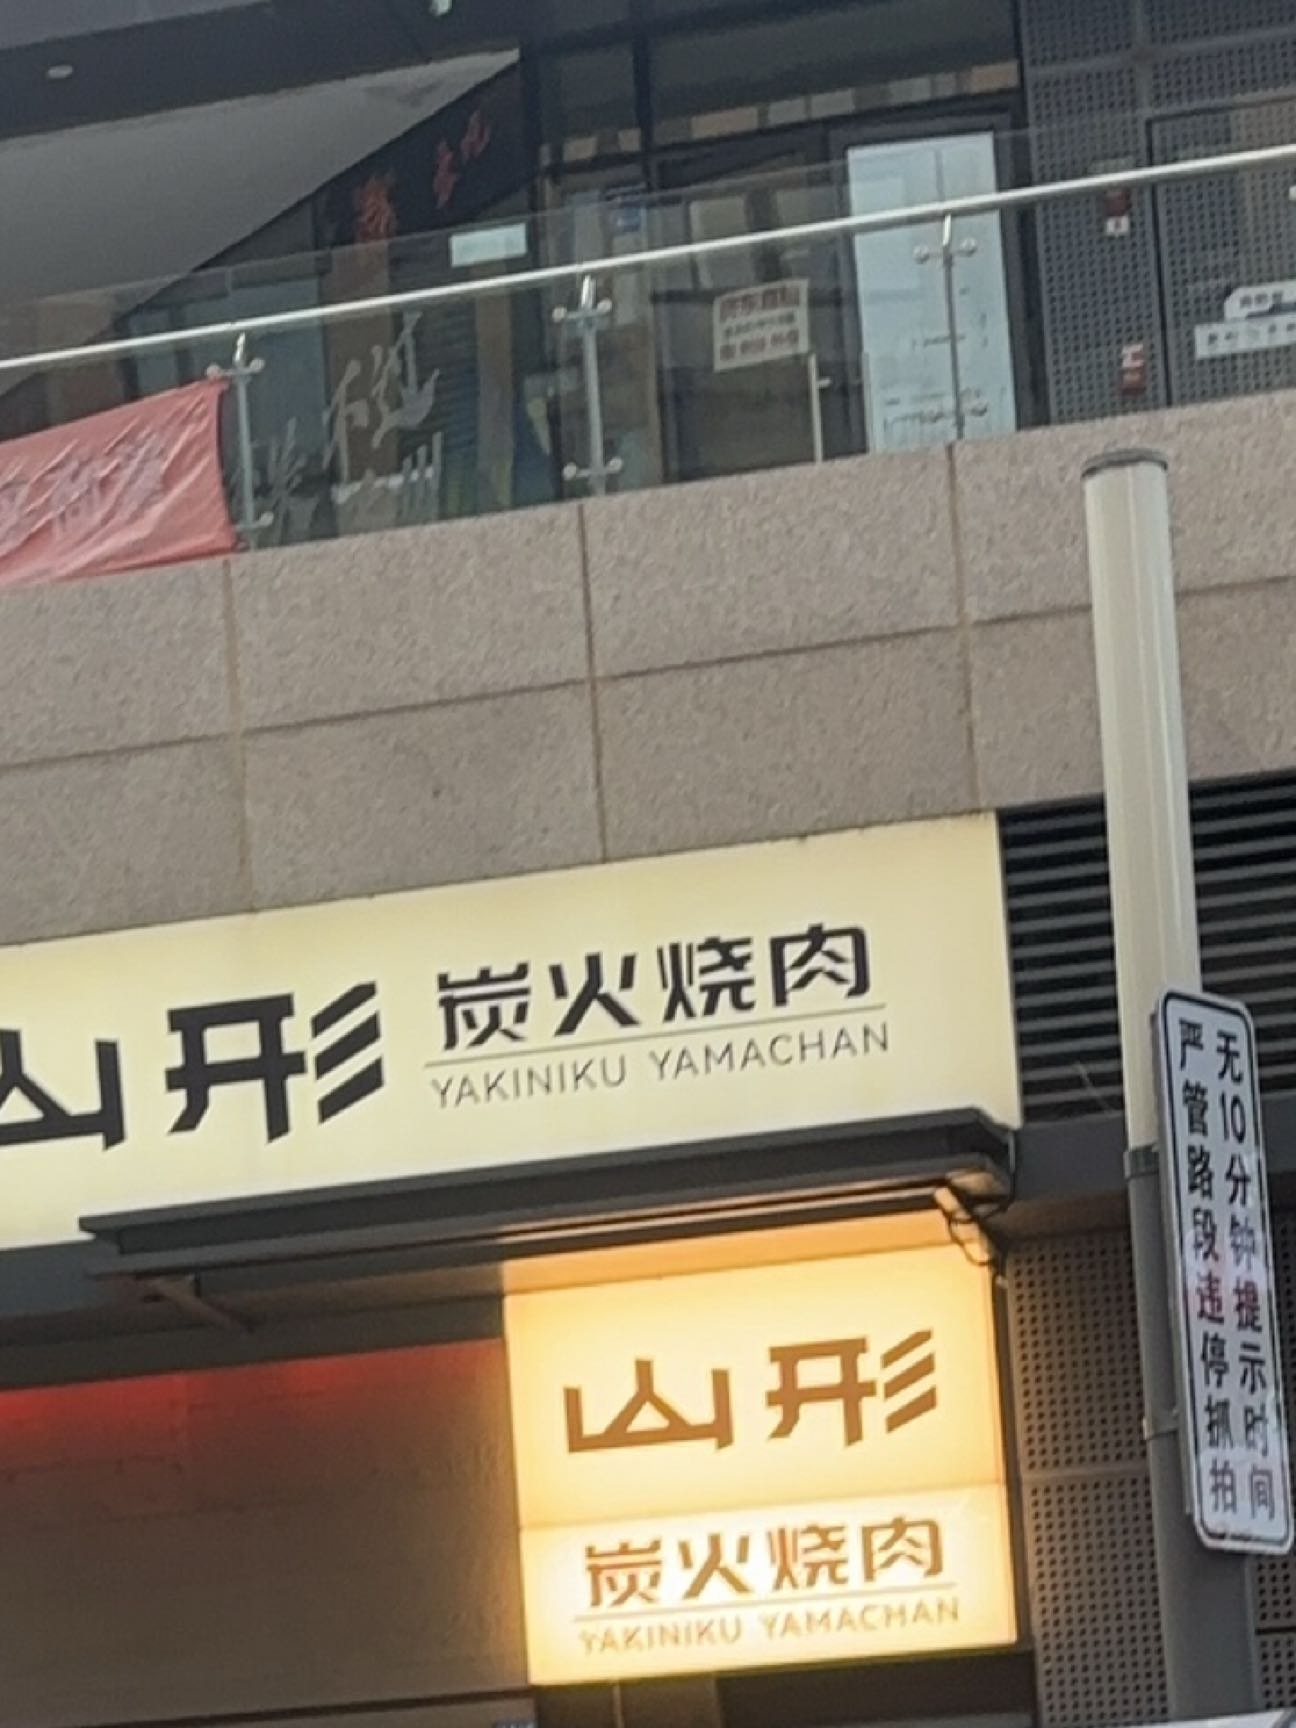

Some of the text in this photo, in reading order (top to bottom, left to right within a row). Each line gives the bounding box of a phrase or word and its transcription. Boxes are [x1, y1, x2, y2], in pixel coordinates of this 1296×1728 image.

[437, 923, 872, 1050] 炭火烧肉
[431, 1022, 890, 1110] YAKINIKU YAMACHAN
[1179, 1016, 1237, 1515] 严管路段违停抓拍
[1216, 1029, 1275, 1521] 无10分钟提示时间
[563, 1328, 938, 1454] 山形
[584, 1516, 944, 1608] 炭火烧肉
[578, 1597, 960, 1657] YAKINIKU YAMACHAN
